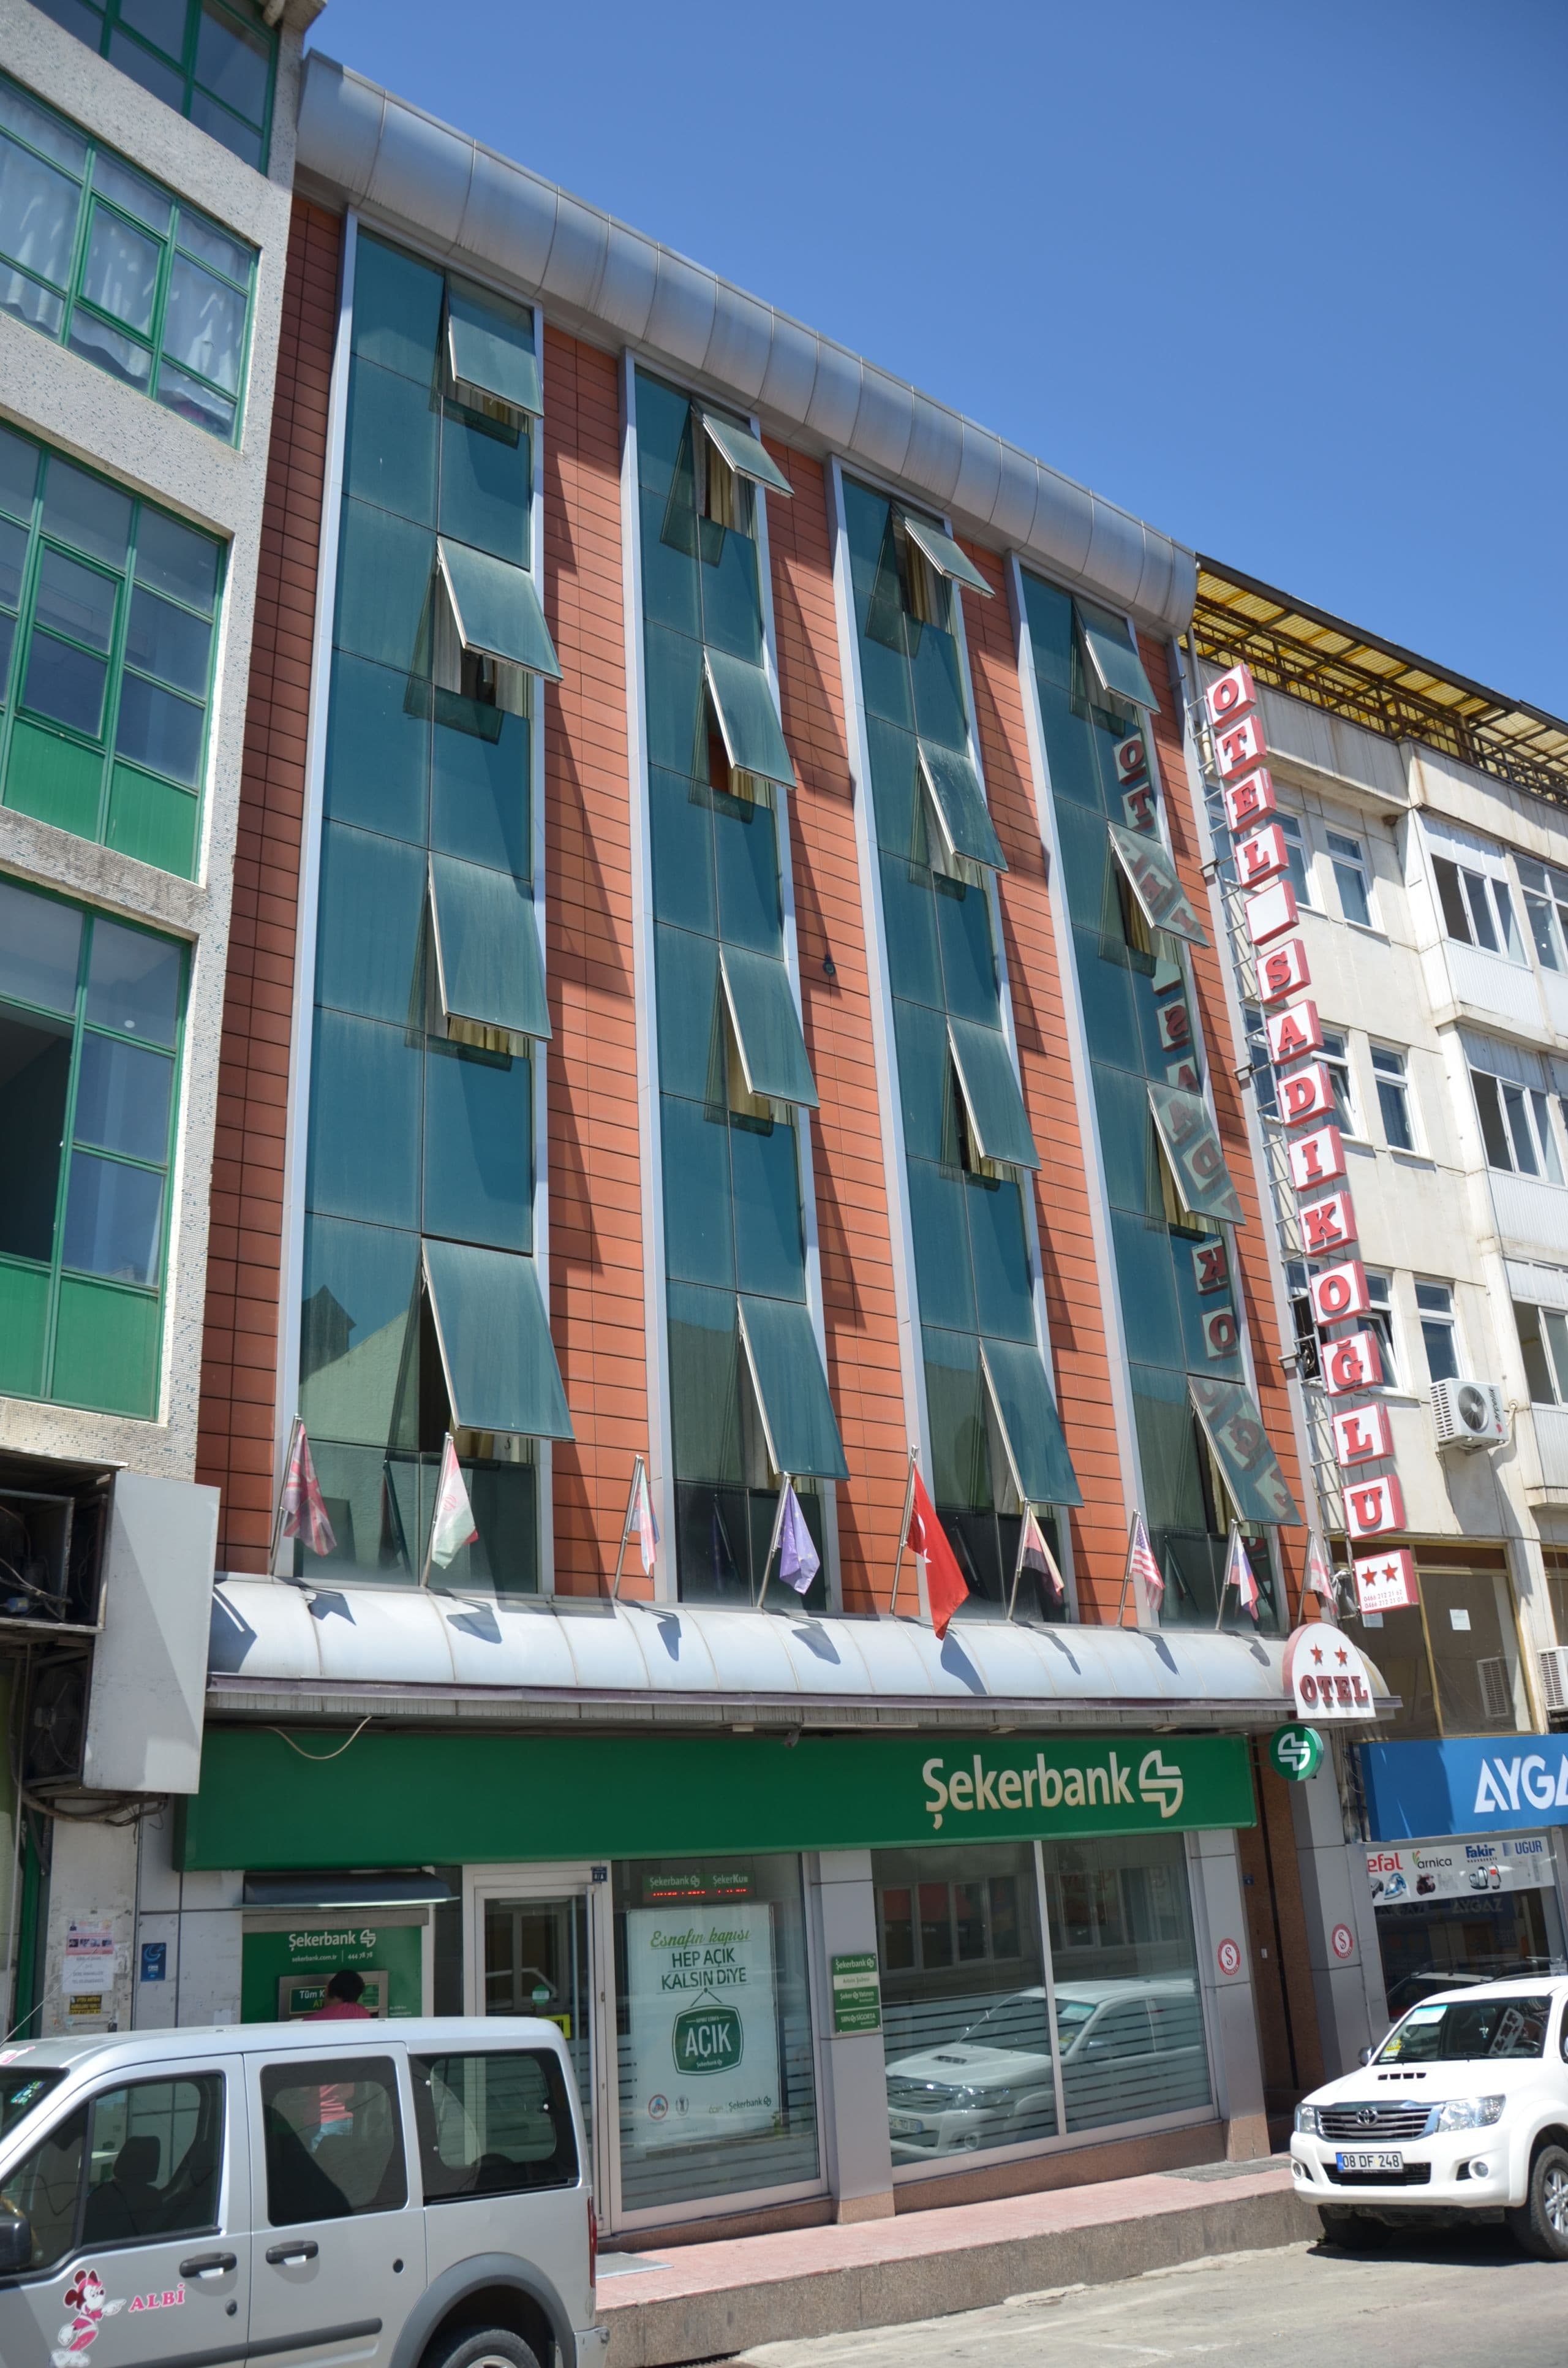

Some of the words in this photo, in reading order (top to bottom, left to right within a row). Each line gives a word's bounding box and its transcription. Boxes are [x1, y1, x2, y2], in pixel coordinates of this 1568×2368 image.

[1213, 677, 1275, 876] OTEL
[1265, 951, 1384, 1527] SADIKOĞLU
[1299, 1674, 1368, 1703] OTEL
[922, 1752, 1135, 1830] Şekerbank
[1367, 1852, 1403, 1873] efal
[1417, 1856, 1452, 1869] arnica
[1465, 1844, 1496, 1859] Fakir
[650, 1876, 689, 1888] Şekerbank
[289, 1930, 356, 1951] Şekerbank
[650, 1928, 704, 1950] Esnafın
[709, 1927, 750, 1946] kapısı
[672, 1951, 700, 1968] HEP
[703, 1948, 736, 1967] AÇIK
[835, 1959, 866, 1970] Şekerbank
[662, 1970, 713, 1990] KALSIN
[300, 1990, 317, 2000] Tüm
[685, 2023, 732, 2057] AÇIK
[728, 2098, 762, 2112] Şekerbank
[1343, 2155, 1356, 2168] 08
[1359, 2155, 1374, 2168] DF
[1378, 2155, 1400, 2168] 248
[128, 2283, 185, 2313] ALBİ
